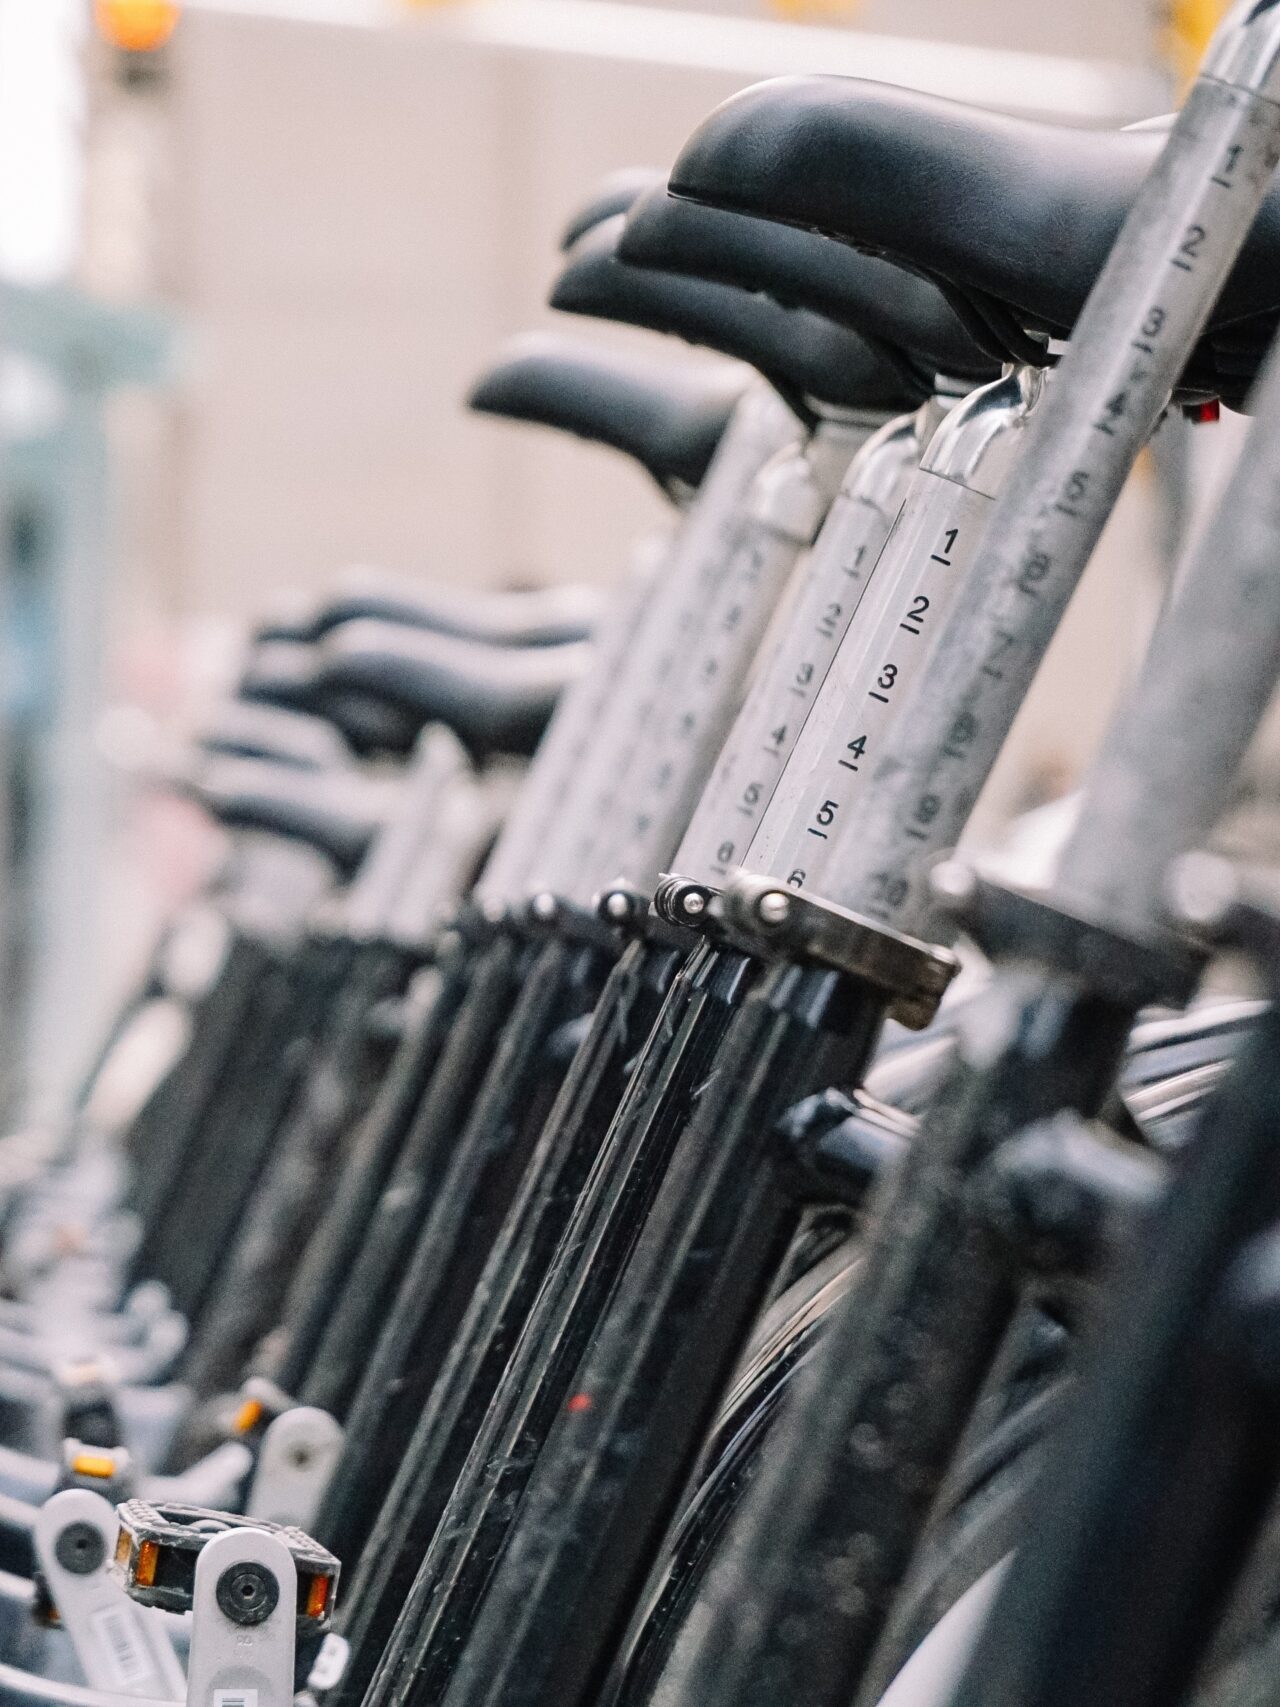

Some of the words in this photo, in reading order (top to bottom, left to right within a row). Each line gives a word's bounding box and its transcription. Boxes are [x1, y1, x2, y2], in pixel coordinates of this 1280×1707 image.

[1224, 143, 1245, 173] 1
[1181, 225, 1207, 258] 2
[1142, 306, 1166, 336] 3
[1065, 471, 1091, 500] 5
[942, 527, 959, 554] 1
[853, 545, 868, 569] 1
[823, 603, 843, 628] 2
[906, 595, 930, 623] 2
[876, 663, 899, 690] 3
[770, 724, 788, 747] 4
[846, 734, 869, 760] 4
[815, 799, 839, 826] 5
